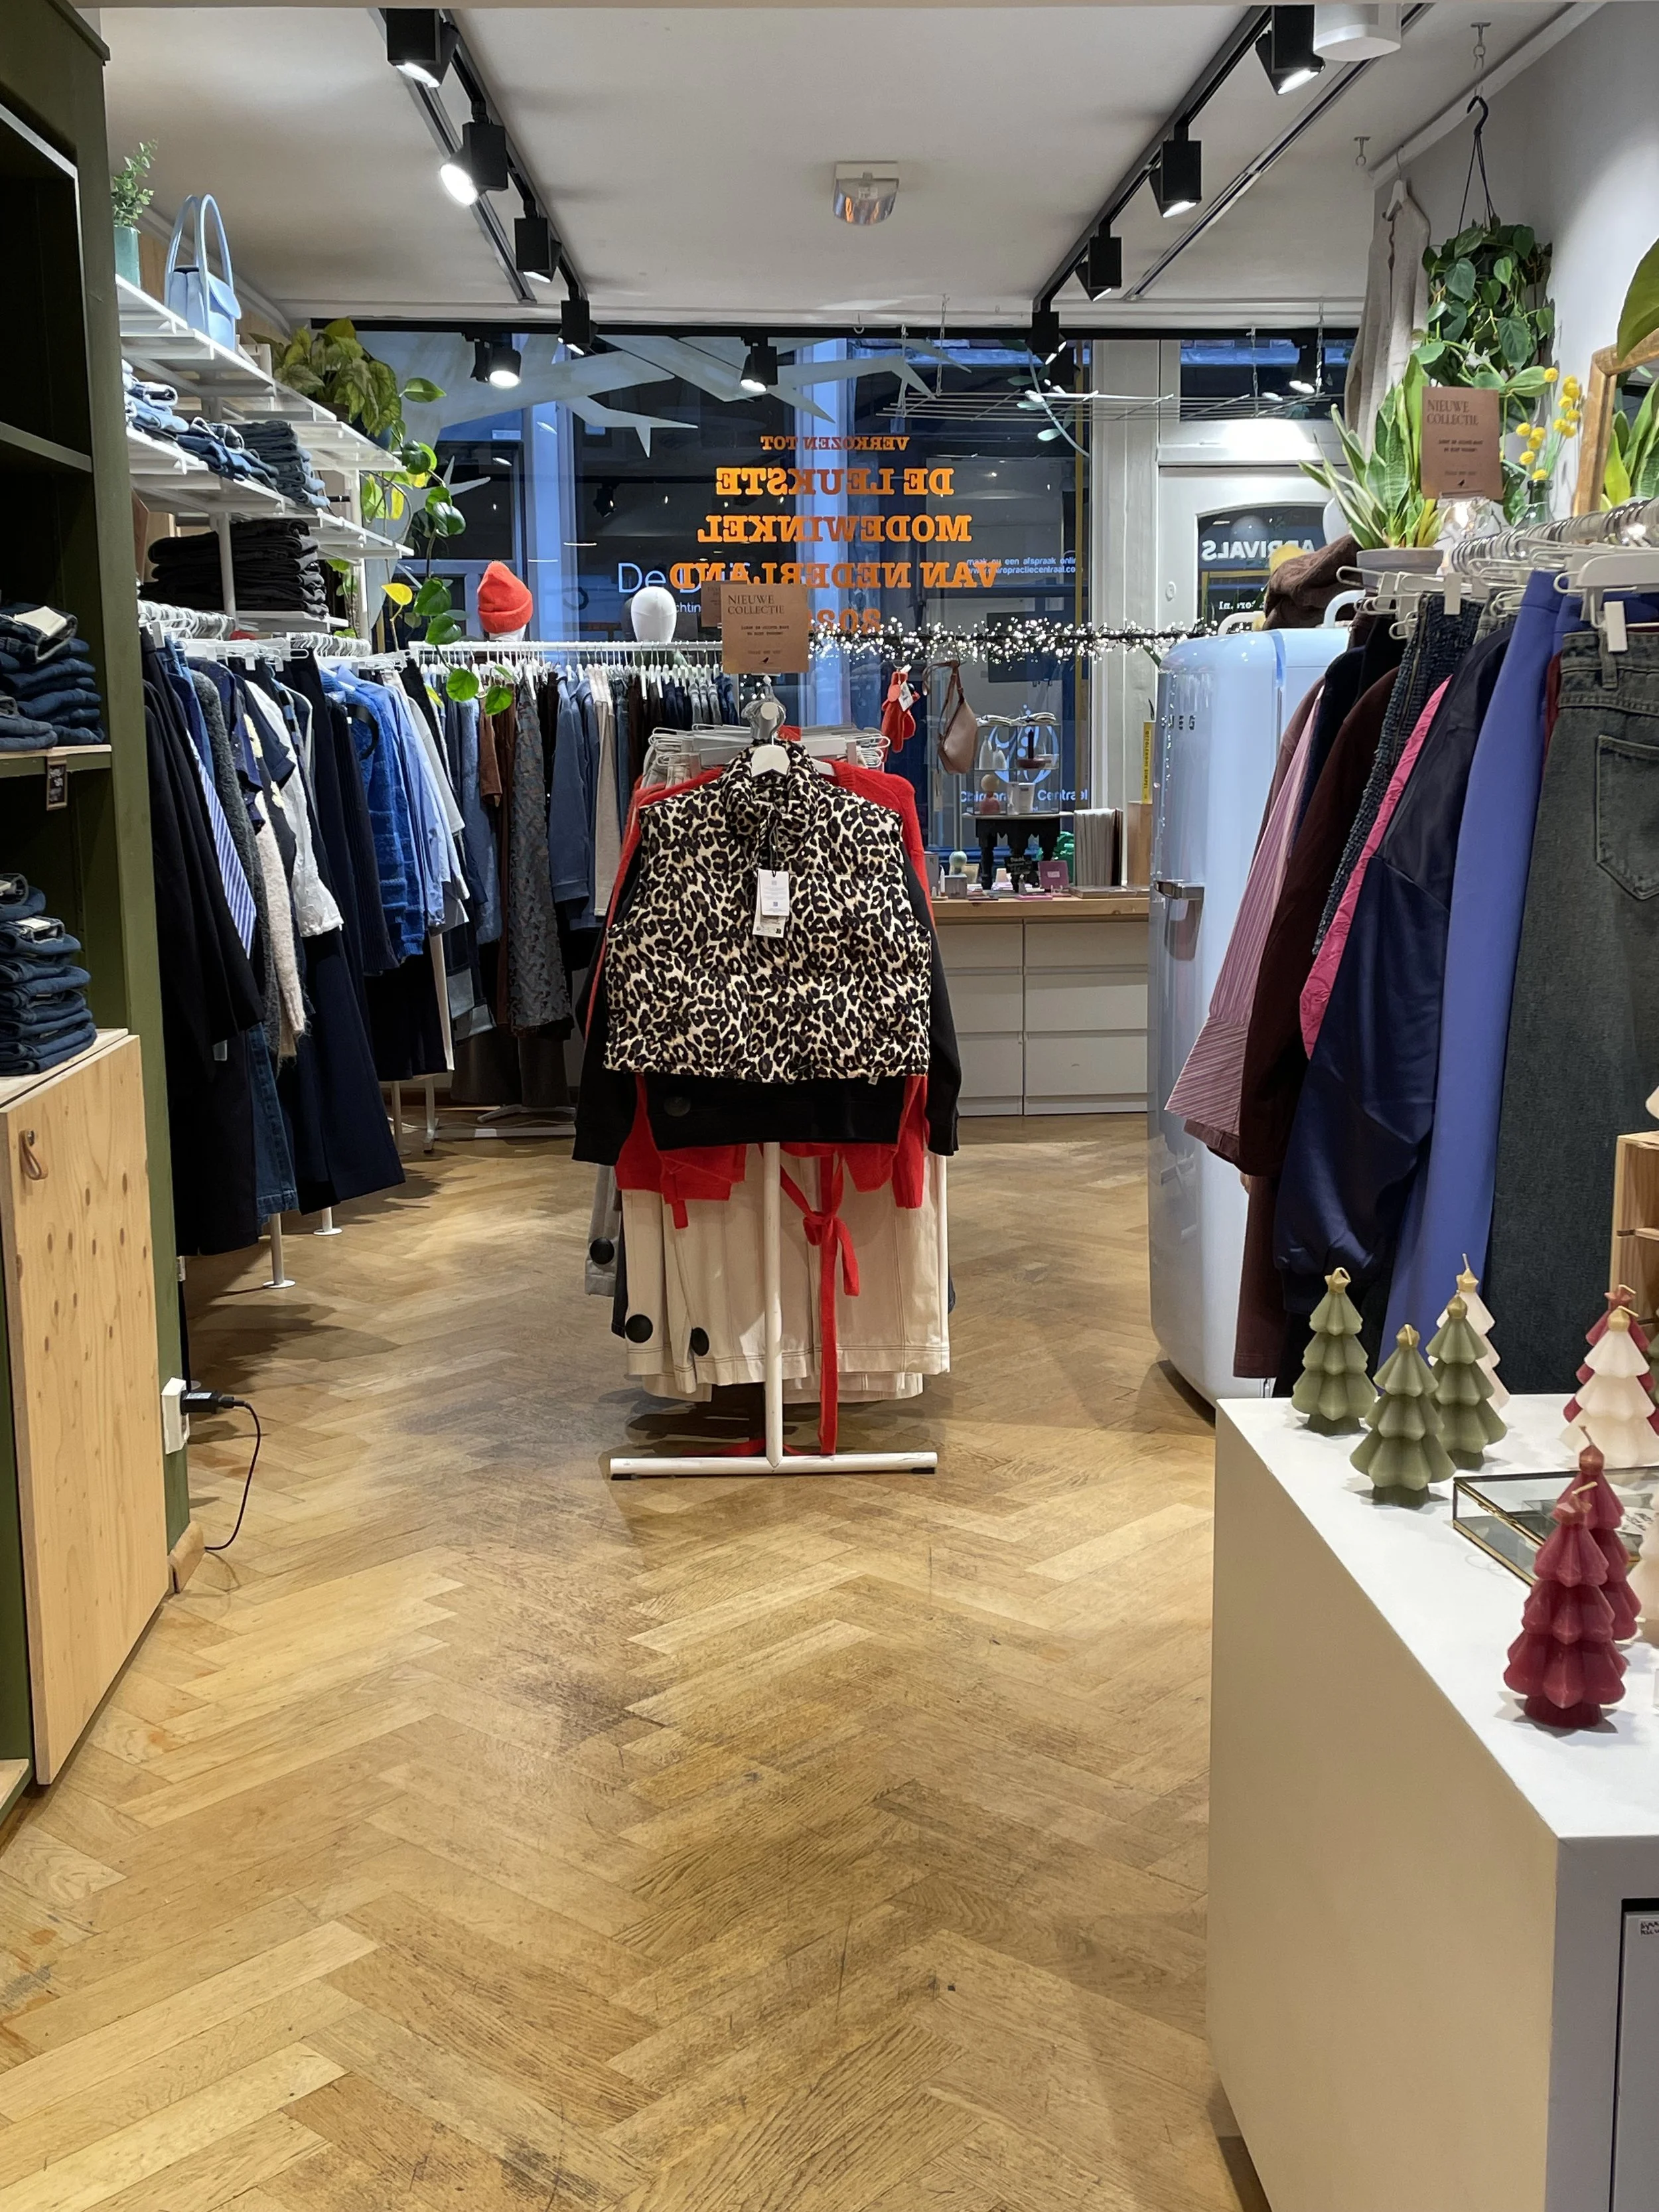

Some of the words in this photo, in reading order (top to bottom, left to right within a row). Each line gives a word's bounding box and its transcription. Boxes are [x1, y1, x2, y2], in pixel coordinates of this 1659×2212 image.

[1427, 400, 1470, 413] NIEUWE
[1023, 557, 1056, 566] afspraak
[618, 562, 666, 593] De
[728, 595, 774, 605] NIEUWE
[727, 605, 784, 615] COLLECTIE
